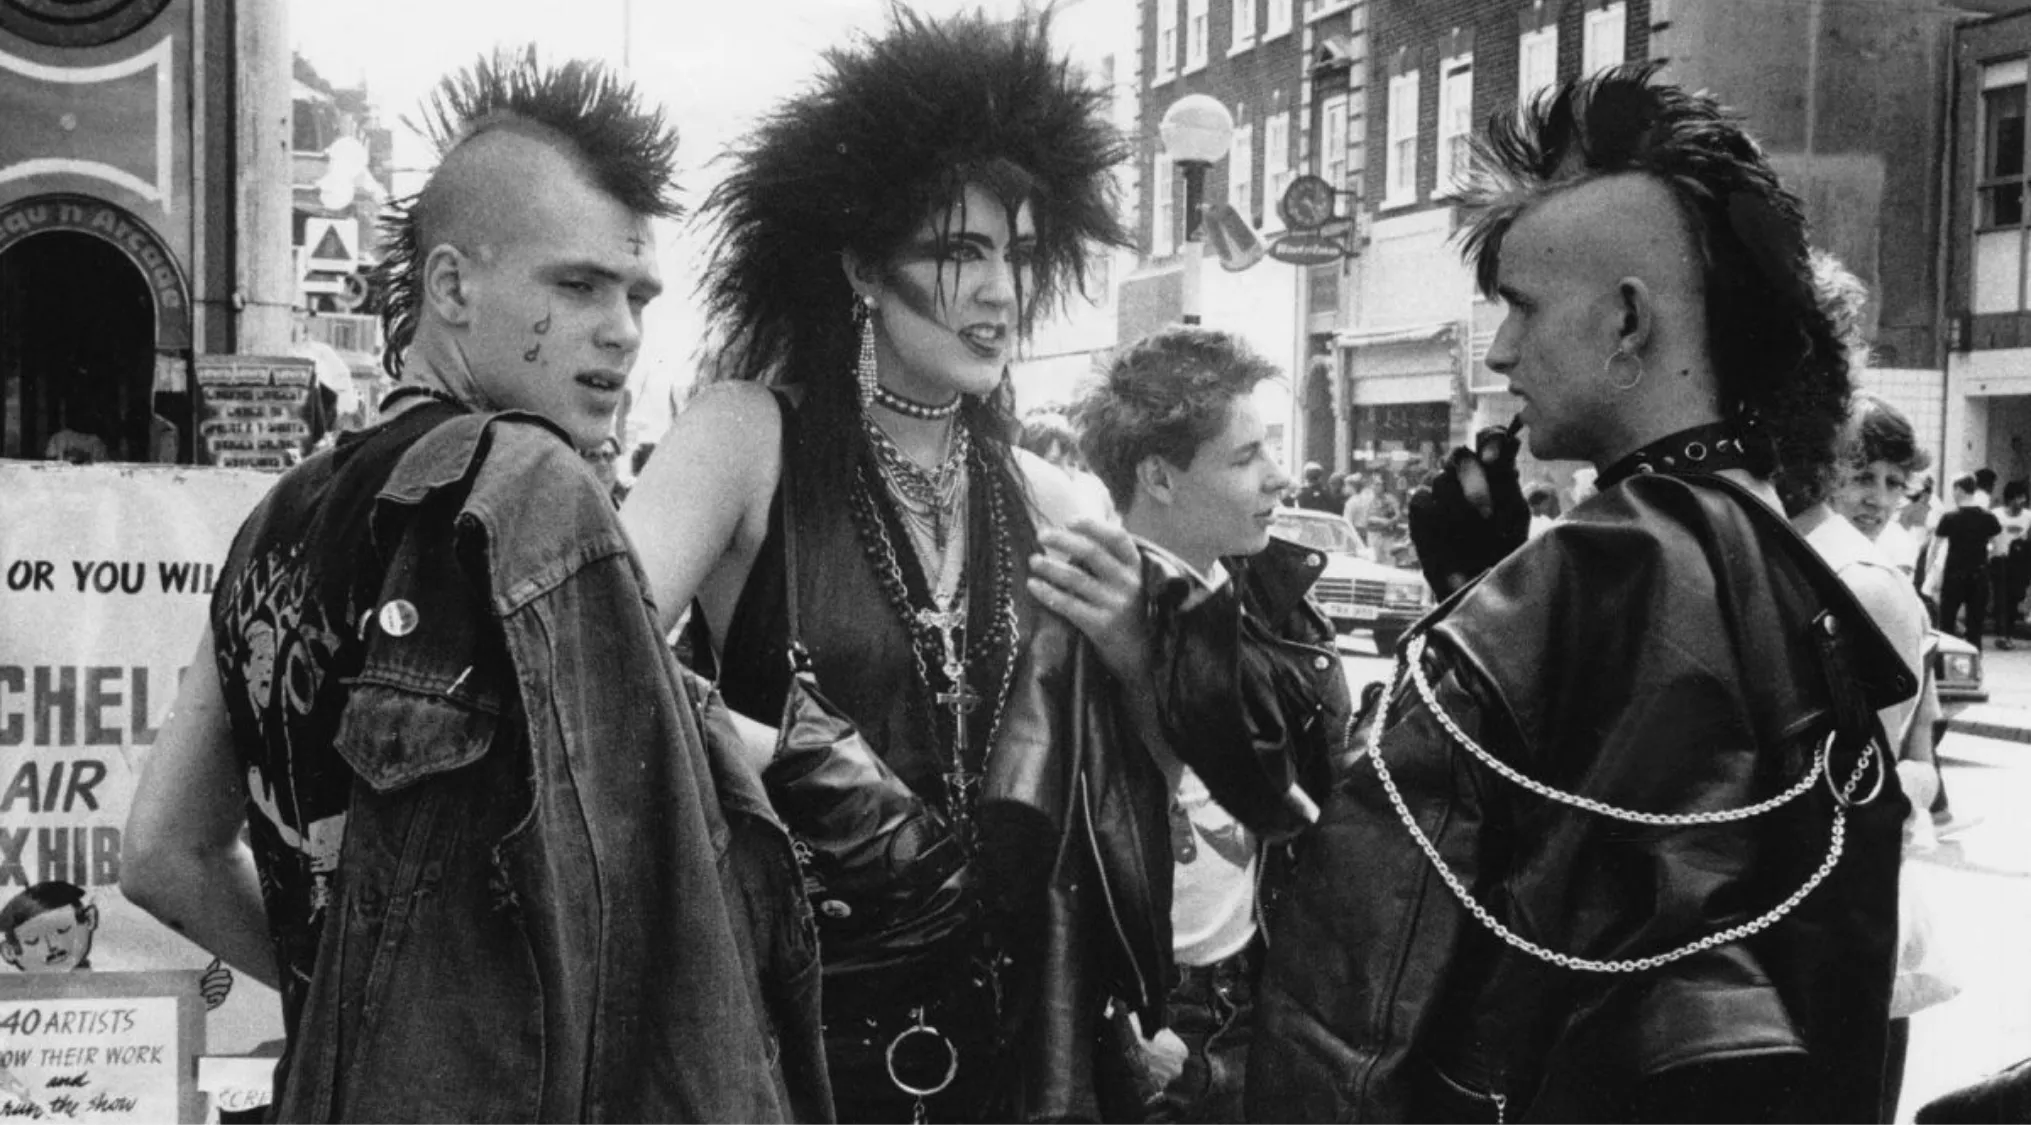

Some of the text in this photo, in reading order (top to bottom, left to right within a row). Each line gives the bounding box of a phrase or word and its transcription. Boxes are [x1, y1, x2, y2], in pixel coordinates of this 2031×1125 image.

[7, 560, 54, 591] OR
[72, 560, 146, 595] YOU
[0, 665, 188, 746] CHEL
[0, 760, 107, 813] AIR
[0, 1008, 138, 1036] 40 ARTISTS
[40, 1047, 99, 1067] THEIR
[105, 1044, 165, 1066] WORK
[45, 1071, 90, 1089] and
[50, 1094, 79, 1119] the
[85, 1092, 137, 1113] show
